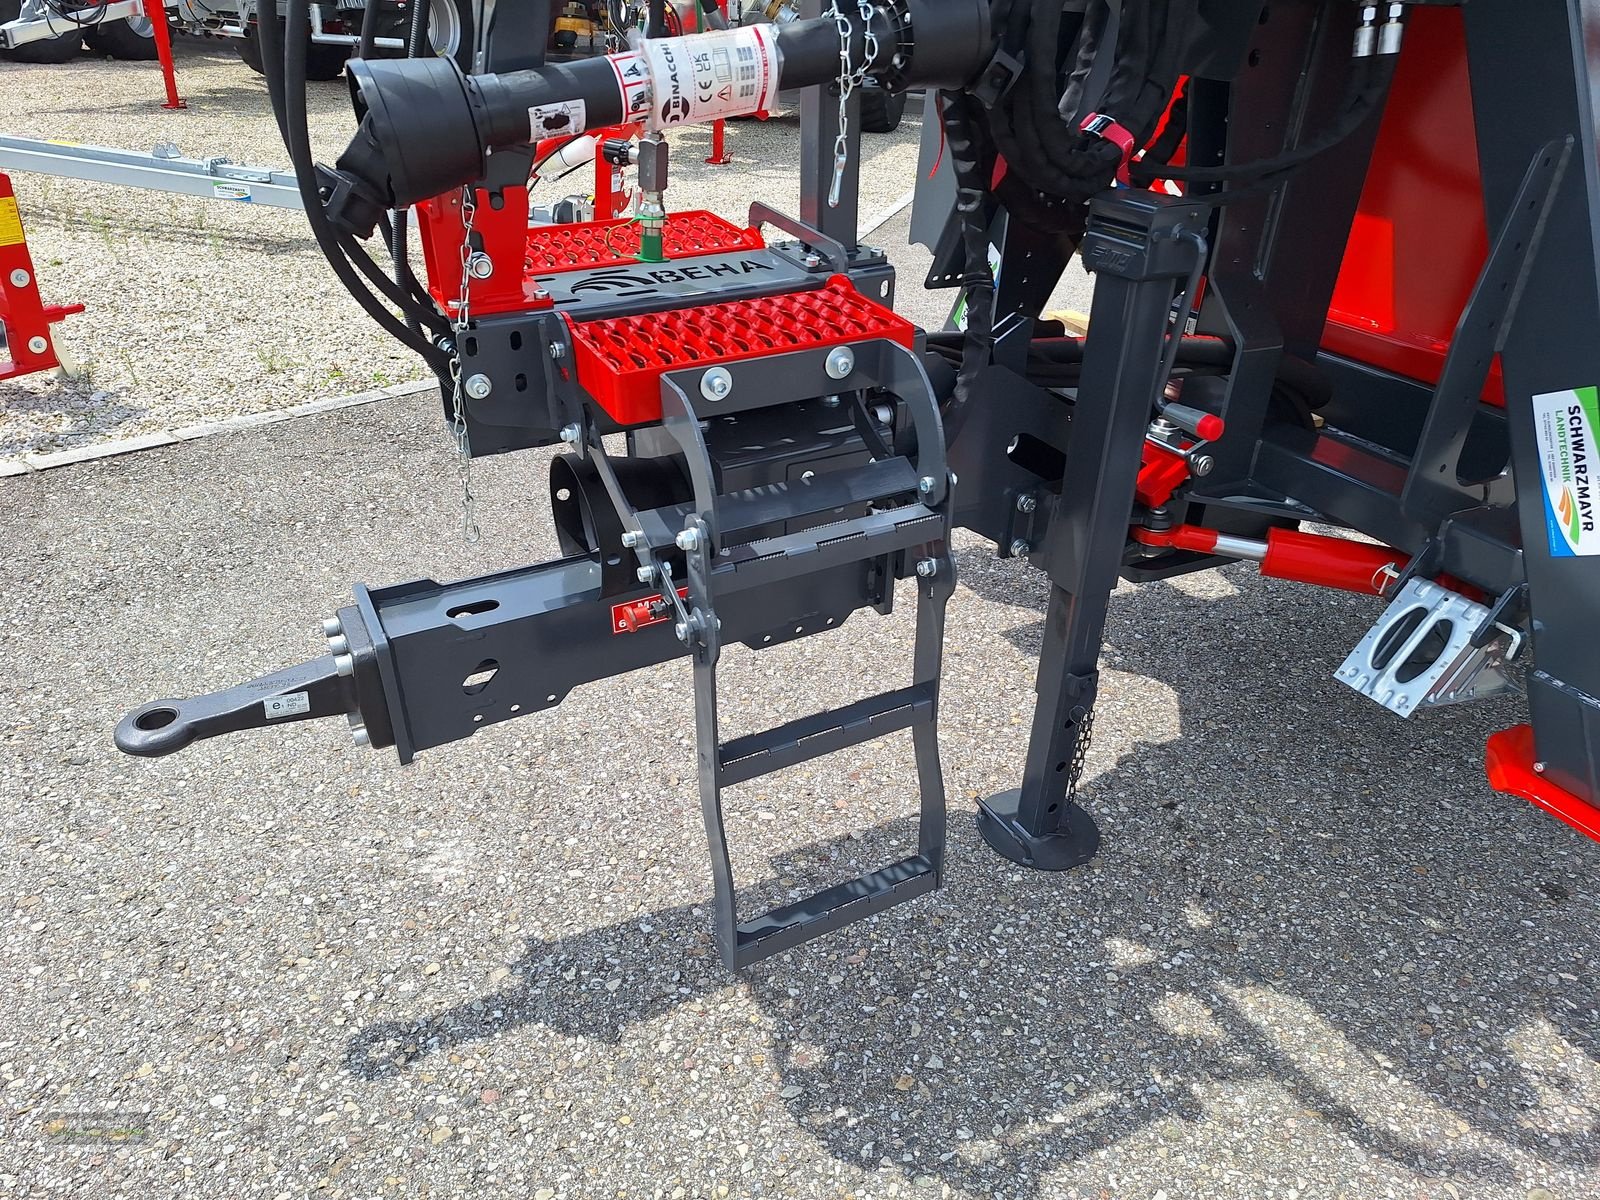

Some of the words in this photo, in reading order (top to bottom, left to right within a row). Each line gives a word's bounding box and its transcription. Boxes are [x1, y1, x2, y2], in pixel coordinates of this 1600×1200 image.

[660, 42, 680, 109] BINACCHI
[647, 260, 774, 283] BEHA
[1555, 410, 1571, 482] LANDTECHNIK
[1568, 405, 1594, 532] SCHWARZMAYR
